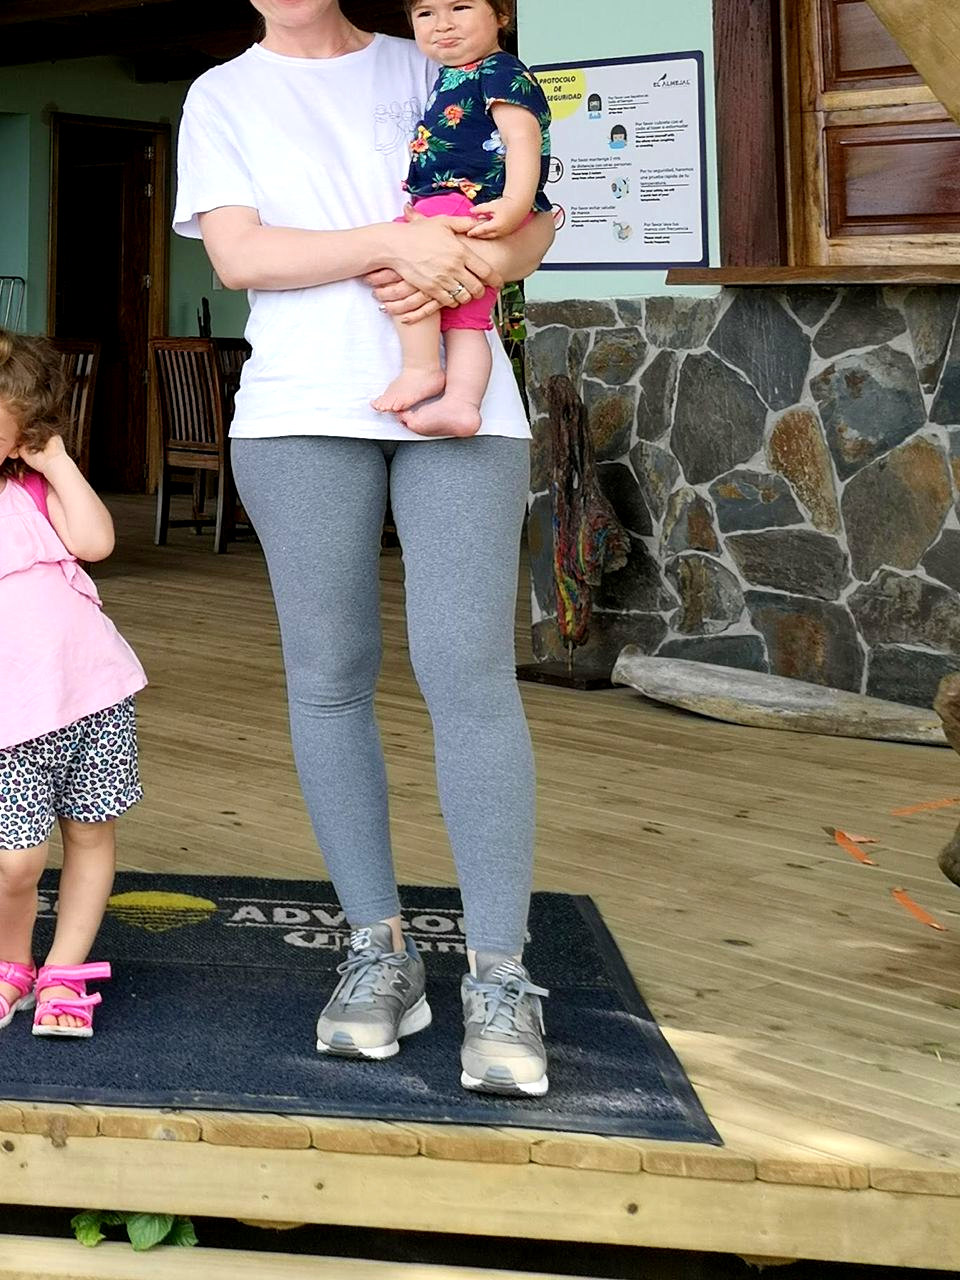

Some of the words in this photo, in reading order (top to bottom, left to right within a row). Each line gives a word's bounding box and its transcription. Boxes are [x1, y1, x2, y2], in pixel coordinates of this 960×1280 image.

[539, 75, 576, 84] PROTOCOLO
[553, 85, 562, 93] DE
[546, 93, 582, 102] SEGURIDAD
